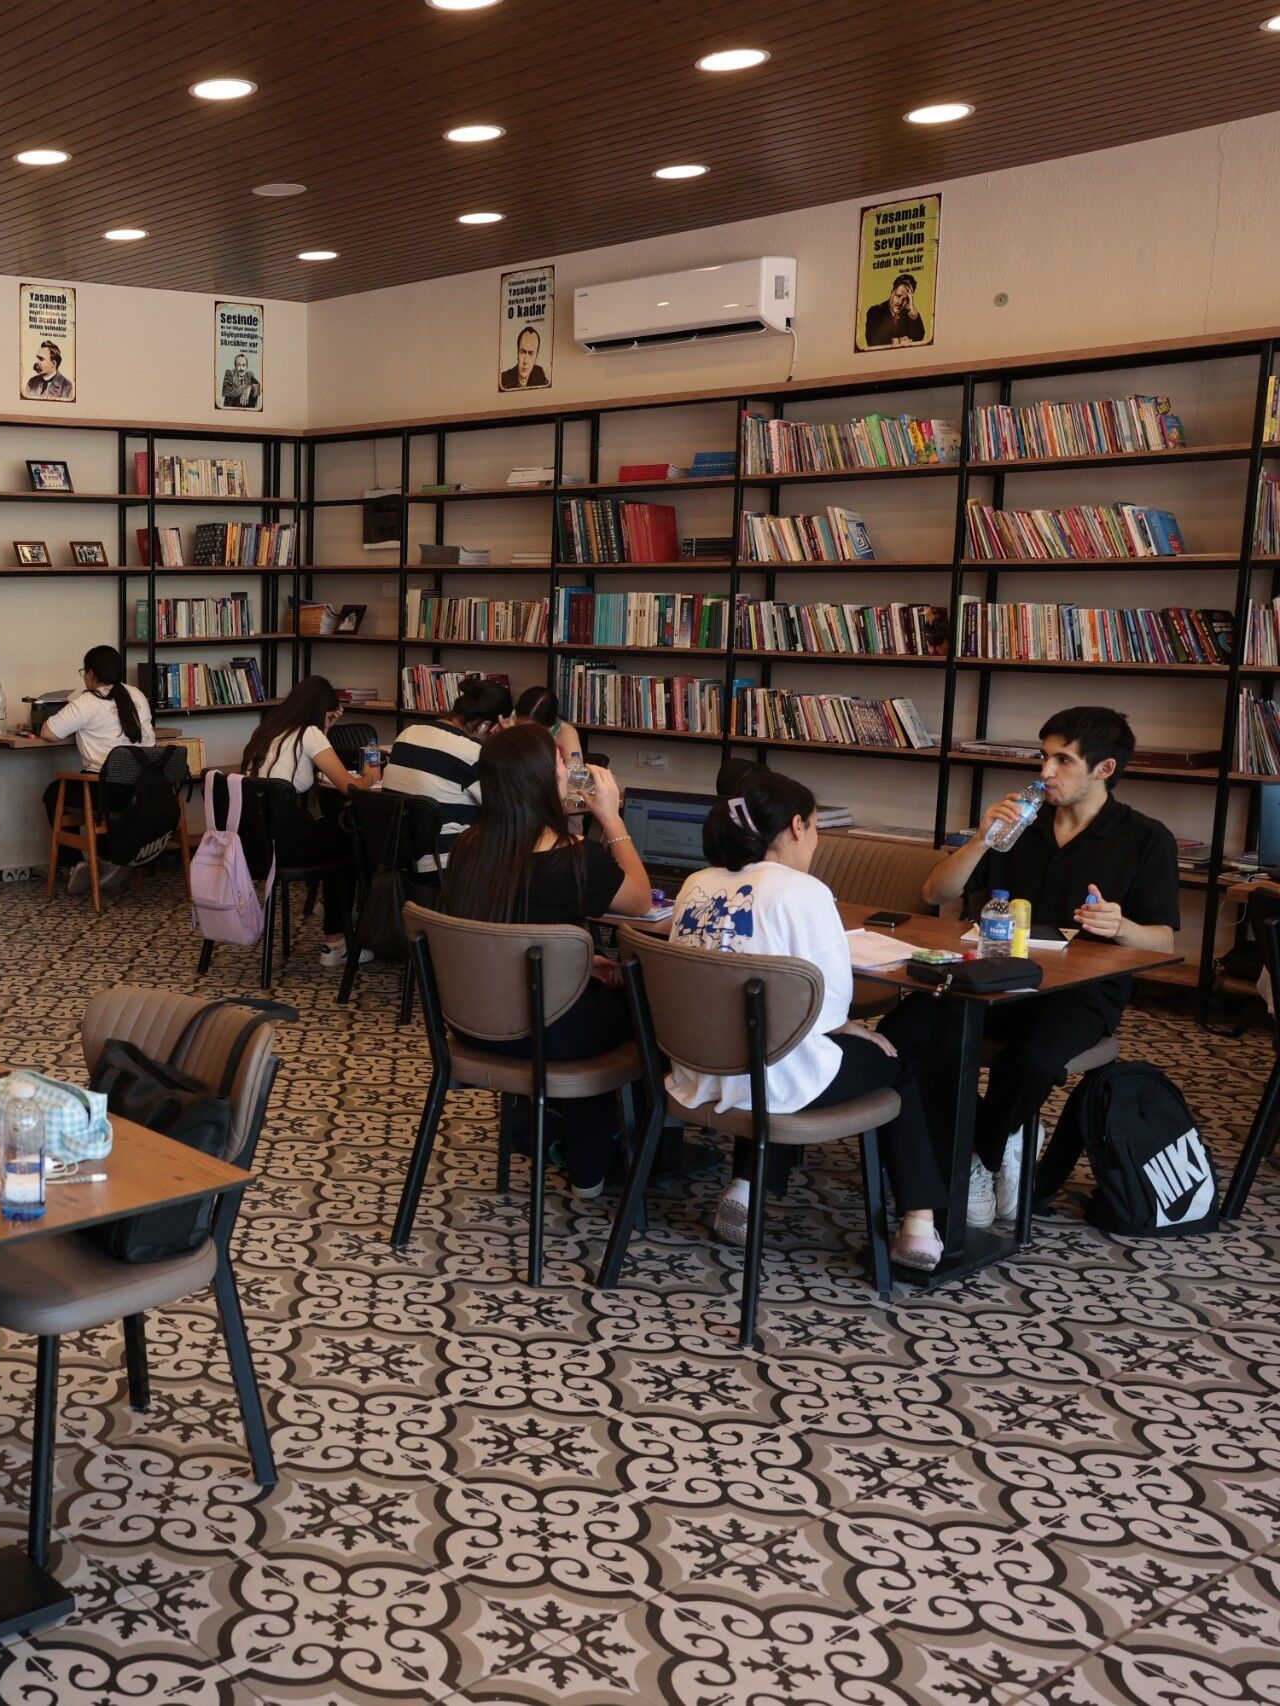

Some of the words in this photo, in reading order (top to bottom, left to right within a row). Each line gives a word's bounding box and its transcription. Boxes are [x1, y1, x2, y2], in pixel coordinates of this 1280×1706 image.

[875, 203, 926, 225] Yaşamak
[897, 223, 908, 233] bir
[874, 232, 925, 251] sevgilim
[872, 258, 892, 270] ciddi
[893, 256, 905, 266] bir
[538, 282, 547, 292] da
[29, 292, 68, 304] Yaşamak
[517, 302, 547, 318] kadar
[58, 317, 68, 325] bir
[220, 313, 258, 326] Sesinde
